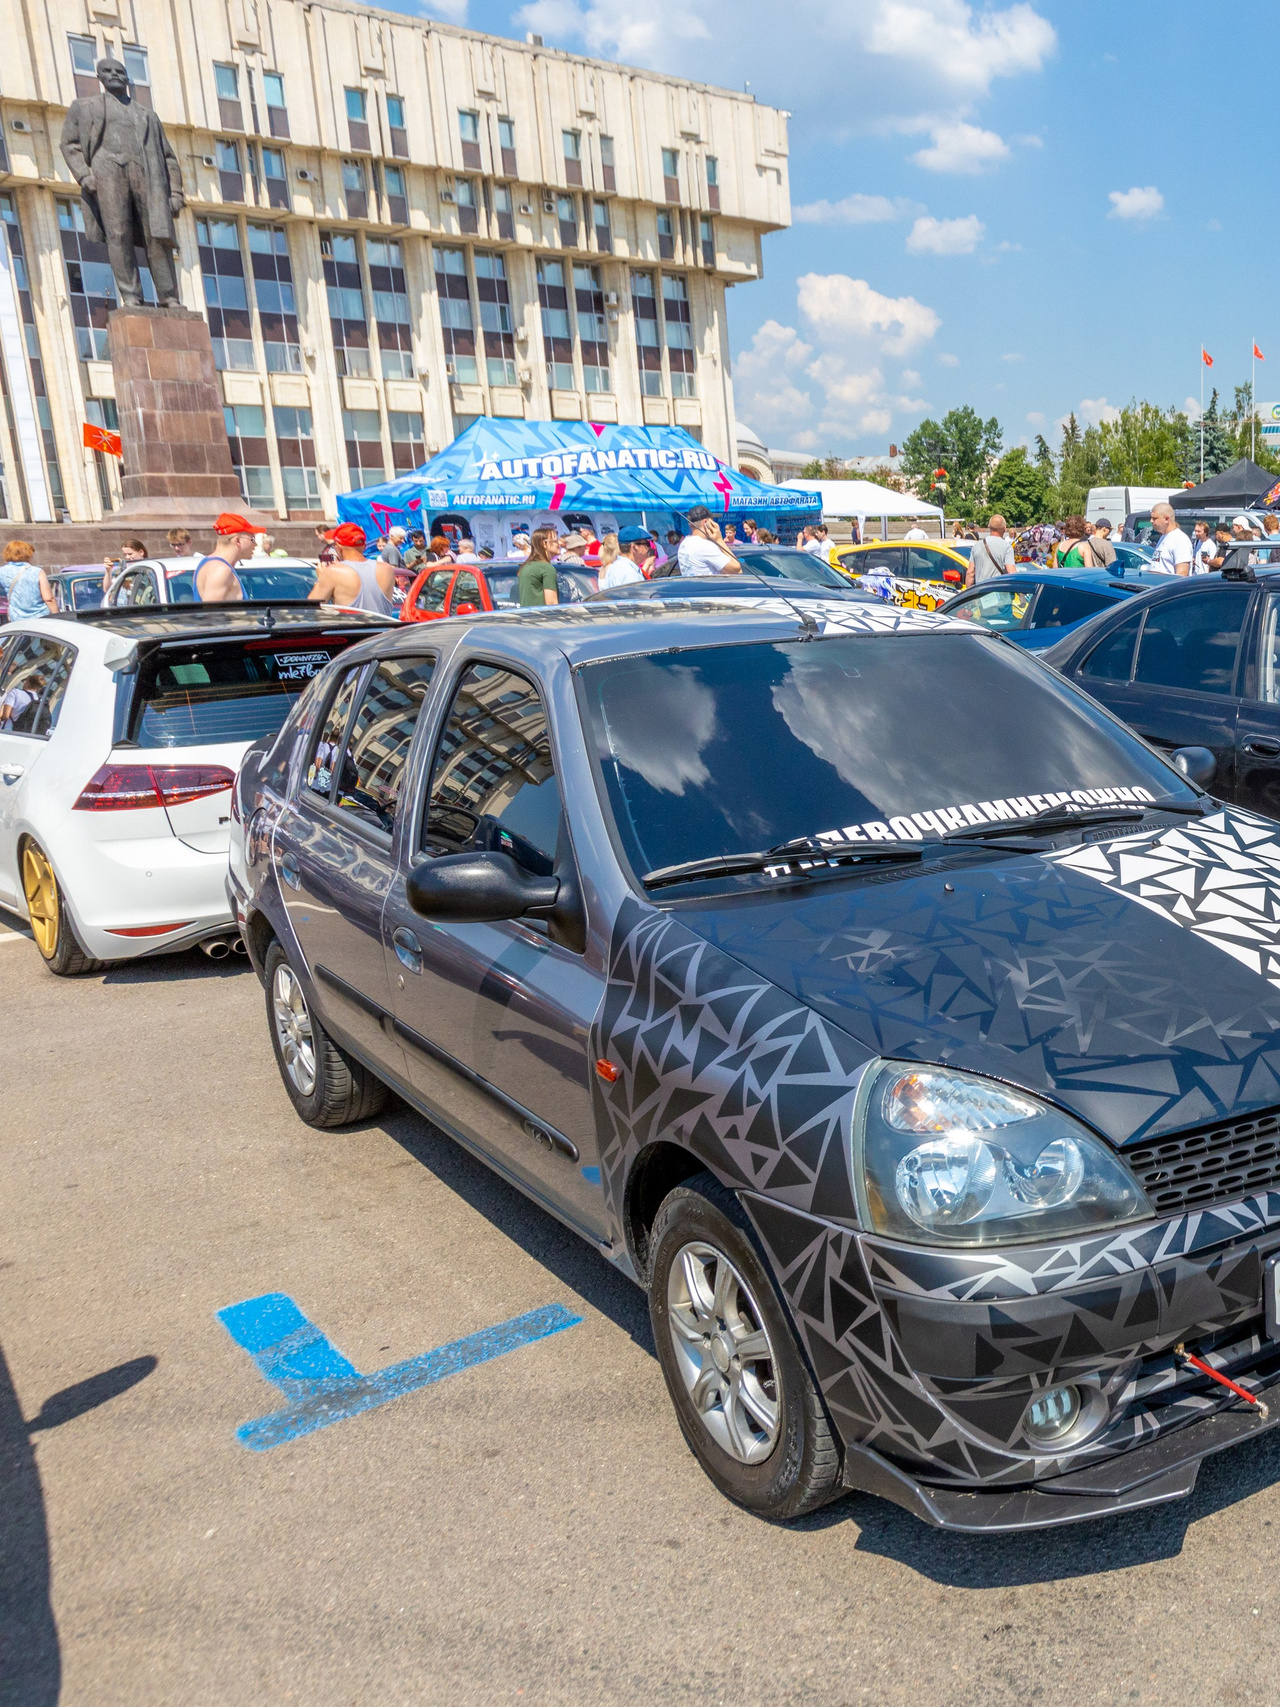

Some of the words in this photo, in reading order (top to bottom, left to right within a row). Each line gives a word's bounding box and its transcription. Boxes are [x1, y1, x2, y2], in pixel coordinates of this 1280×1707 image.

[479, 447, 718, 482] AUTOFANATIC.RU
[452, 494, 536, 506] AUTOFANATIC.RU
[732, 496, 768, 506] МАГАЗИН
[769, 496, 818, 505] АВТОФАНАТА
